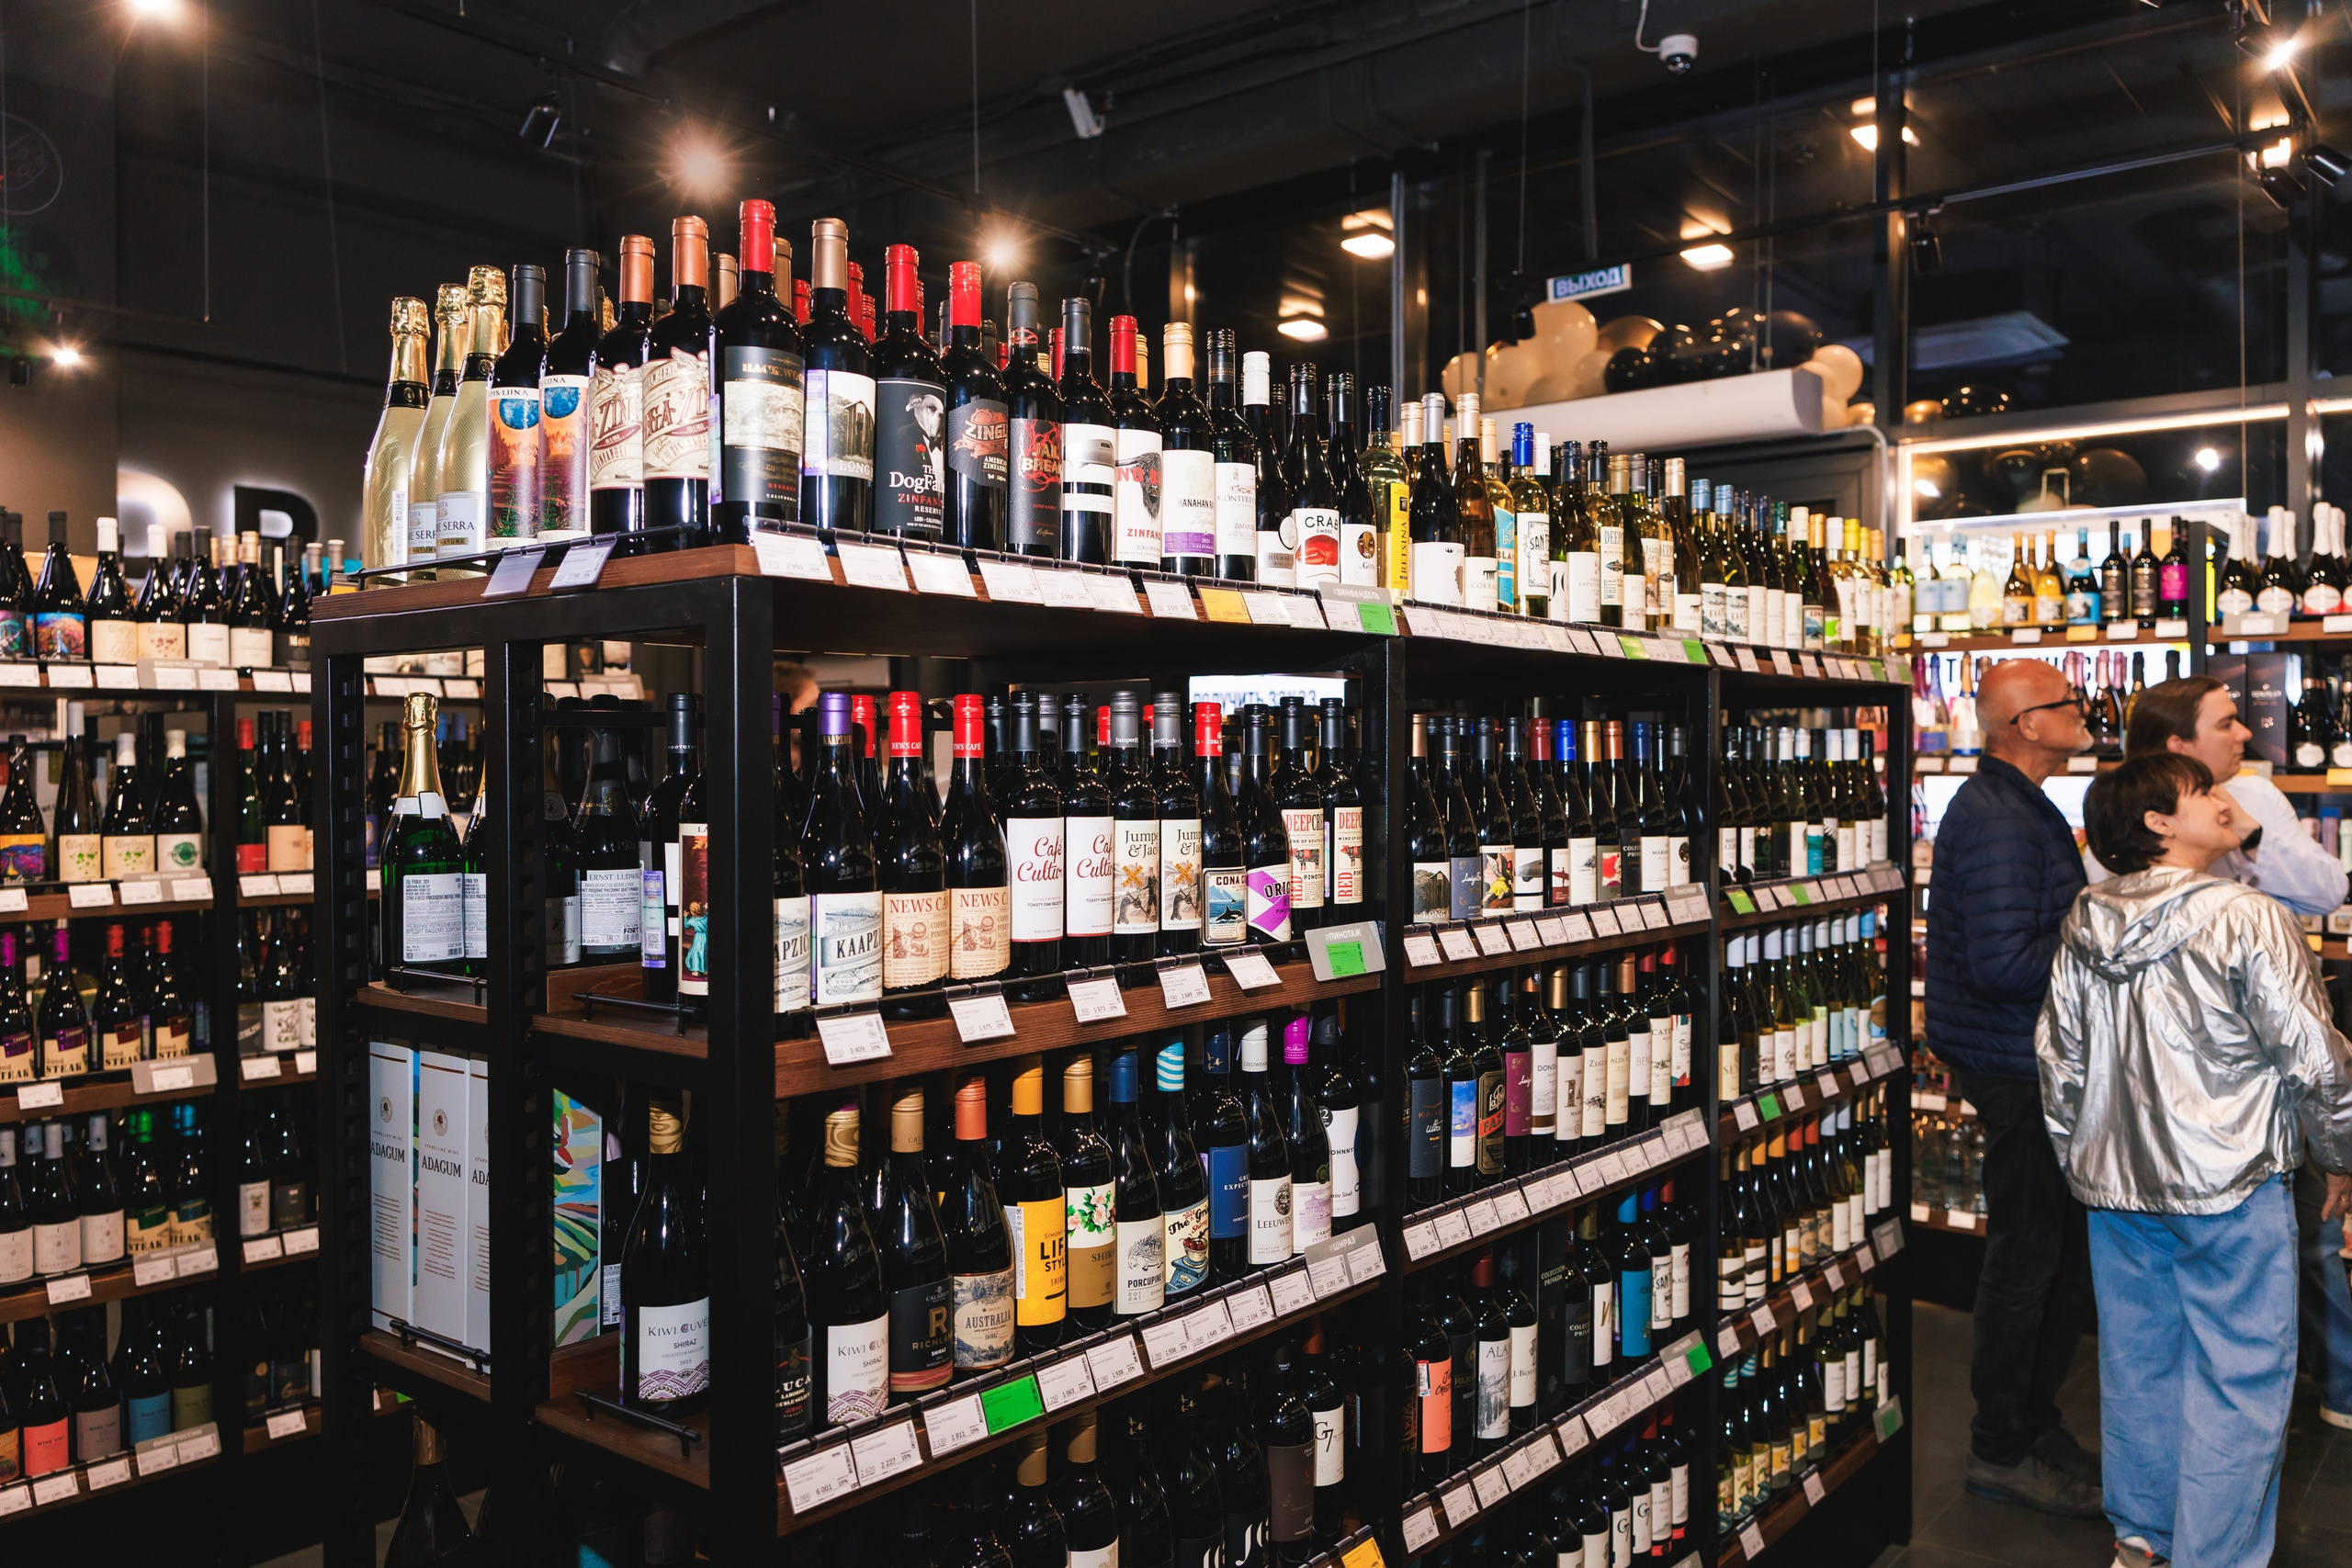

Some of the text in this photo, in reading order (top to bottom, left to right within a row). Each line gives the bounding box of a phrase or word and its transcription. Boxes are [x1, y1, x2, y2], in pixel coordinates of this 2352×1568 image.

[1555, 265, 1622, 297] ВЫХОД
[1033, 443, 1059, 459] JAIL
[839, 459, 870, 474] LONG
[889, 471, 944, 493] DogFa
[1117, 468, 1144, 482] NO
[444, 520, 474, 532] SERRA
[1305, 515, 1338, 530] CRAB
[892, 741, 912, 750] NEWS
[966, 740, 981, 750] CAFÉ
[1128, 843, 1141, 857] &
[1181, 841, 1191, 855] &
[1216, 876, 1239, 886] CONA
[1338, 872, 1352, 897] RED
[889, 897, 933, 913] NEWS
[960, 893, 999, 908] NEWS
[1325, 928, 1362, 941] #ПИНОТАЖ
[0, 1067, 29, 1079] TEAK
[46, 1063, 82, 1074] STEAK
[372, 1130, 391, 1139] SPARKLING
[371, 1141, 405, 1163] ADAGUM
[424, 1143, 446, 1153] SPARKLING
[422, 1156, 461, 1178] ADAGUM
[1168, 1219, 1190, 1235] The
[1329, 1235, 1356, 1251] #ШИРАЗ
[1127, 1274, 1161, 1289] PORCUPINE
[929, 1306, 947, 1337] R
[966, 1310, 1011, 1328] AUSTRALIA
[649, 1326, 676, 1337] KIWI
[673, 1338, 697, 1349] SHIRAZ
[838, 1344, 866, 1357] KIWI
[931, 1348, 946, 1357] SHIRAZ
[863, 1356, 882, 1368] SHIRAZ
[775, 1374, 811, 1393] UCA
